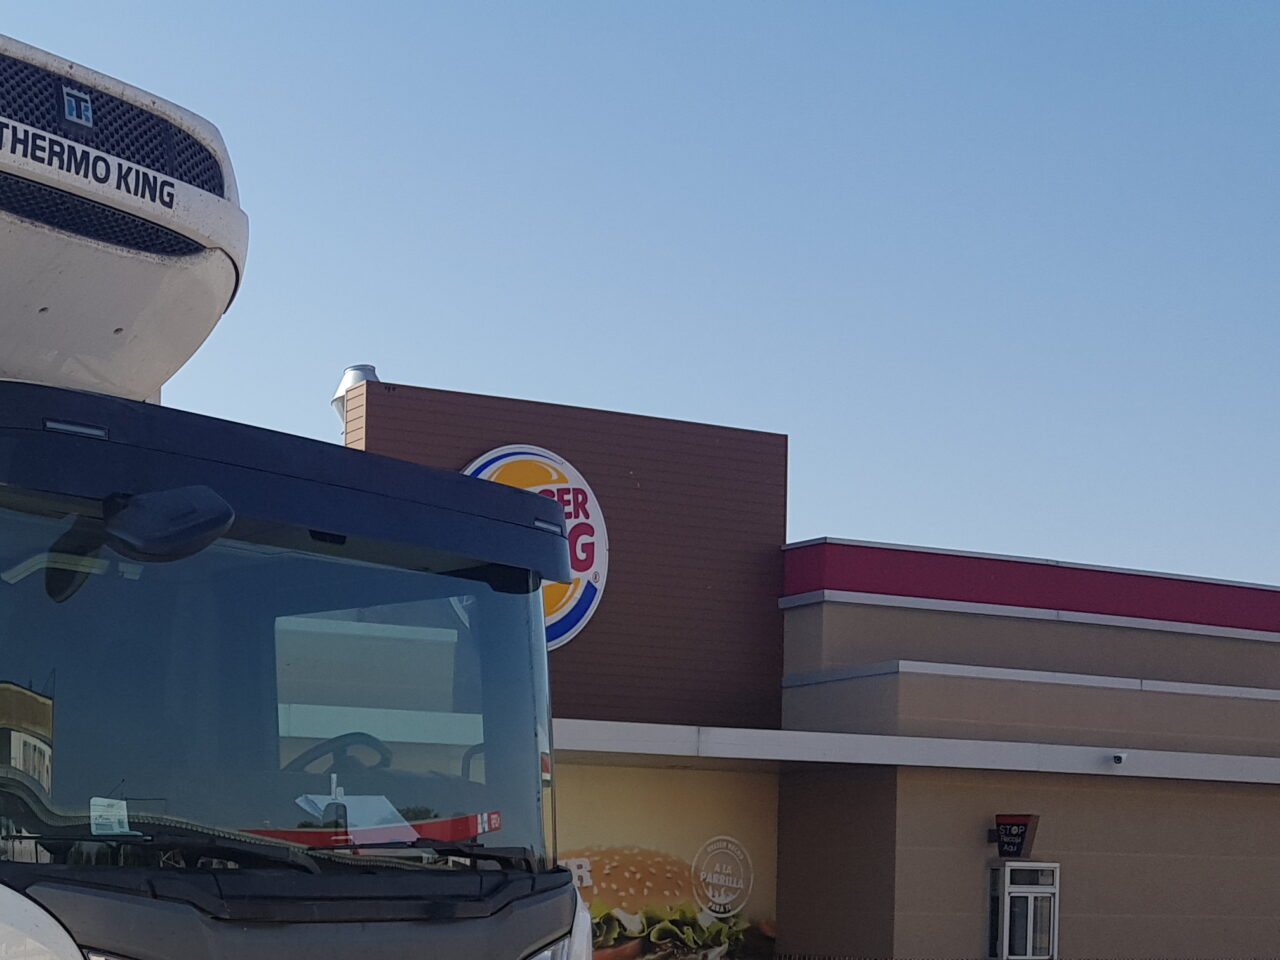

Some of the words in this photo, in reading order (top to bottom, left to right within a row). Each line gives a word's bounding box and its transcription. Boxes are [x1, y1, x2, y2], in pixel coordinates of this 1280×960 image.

[116, 162, 175, 210] KING
[999, 824, 1026, 835] STOP
[714, 863, 720, 873] A
[722, 864, 732, 874] LA
[700, 871, 744, 889] PARRILLA
